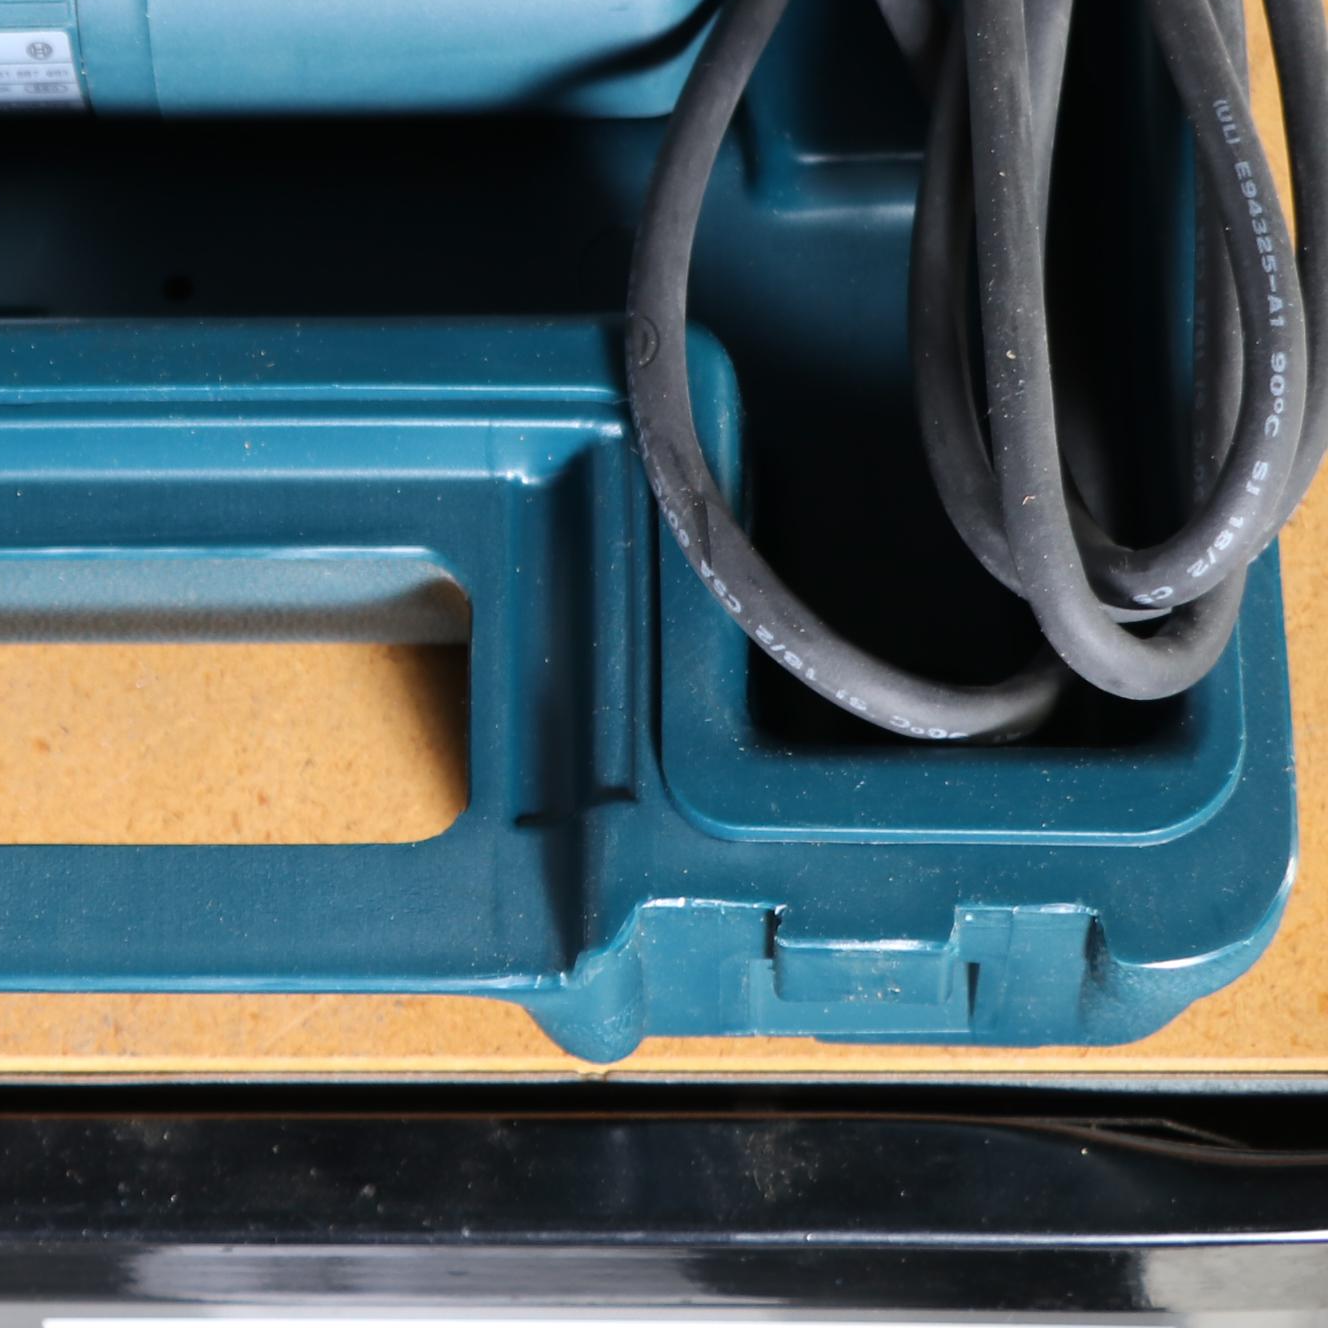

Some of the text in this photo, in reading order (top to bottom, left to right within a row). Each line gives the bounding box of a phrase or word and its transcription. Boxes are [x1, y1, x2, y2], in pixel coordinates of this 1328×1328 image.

[1233, 160, 1286, 330] E94325-A1
[1186, 512, 1246, 581] 18/2
[700, 558, 743, 615] CSA
[1130, 583, 1176, 609] CS
[754, 624, 819, 683] 18/2
